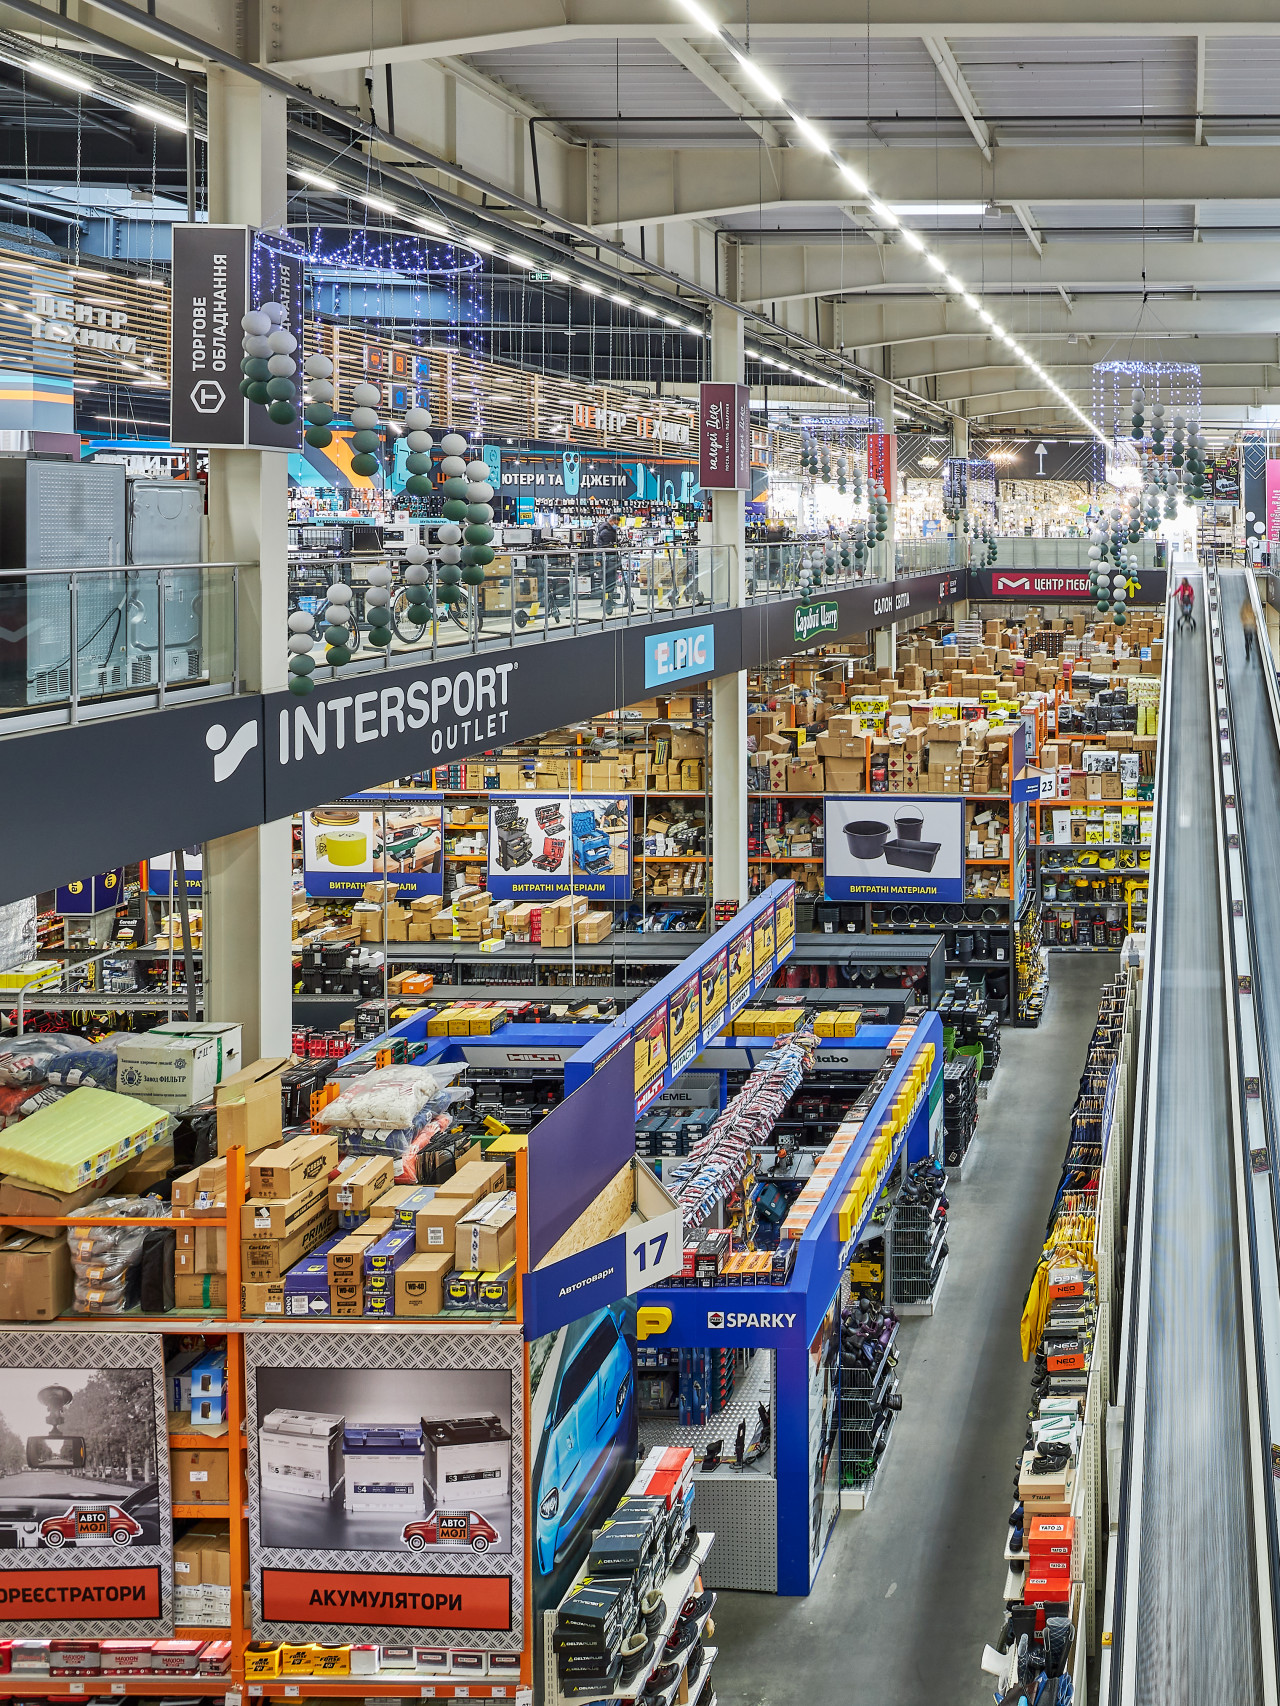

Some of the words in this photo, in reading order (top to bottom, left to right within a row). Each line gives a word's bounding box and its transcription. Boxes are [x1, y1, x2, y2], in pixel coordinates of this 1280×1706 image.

[36, 296, 128, 329] ЦЕНТР
[212, 254, 229, 372] ОБЛАДНАННЯ
[31, 319, 137, 354] ТЕХНІКИ
[193, 296, 207, 372] ТОРГОВЕ
[573, 404, 627, 433] ЦЕНТР
[636, 416, 690, 444] ТЕХНІКИ
[549, 474, 564, 486] ТА
[1034, 578, 1061, 592] ЦЕНТР
[1066, 578, 1095, 592] МЕБЛ
[873, 598, 893, 616] САЛОН
[279, 662, 513, 766] INTERSPORT
[430, 711, 509, 755] OUTLET
[1041, 780, 1053, 793] 23
[511, 883, 554, 892] ВИТРАТНІ
[556, 883, 606, 892] МАТЕРІАЛИ
[849, 885, 889, 894] ВИТРАТНІ
[891, 885, 938, 895] МАТЕРІАЛИ
[672, 1043, 697, 1074] HITACHI
[815, 1054, 849, 1065] tabo
[143, 1075, 159, 1083] Завод
[159, 1075, 187, 1083] ФИЛЬТР
[636, 1074, 664, 1116] HILTI
[659, 1093, 692, 1101] REMEL
[301, 1213, 334, 1247] PRIME
[632, 1231, 669, 1273] 17
[335, 1256, 351, 1264] WD-40
[558, 1266, 615, 1298] Автотовари
[1057, 1285, 1076, 1293] NEO
[726, 1313, 797, 1328] SPARKY
[1053, 1342, 1079, 1350] NEO
[1056, 1357, 1076, 1365] NEO
[79, 1512, 106, 1523] АВТО
[440, 1518, 466, 1528] АВТО
[79, 1523, 107, 1533] МОЛ
[440, 1529, 466, 1539] МОЛ
[309, 1588, 463, 1613] АКУМУЛЯТОРИ
[570, 1620, 596, 1628] DELTAPLUS
